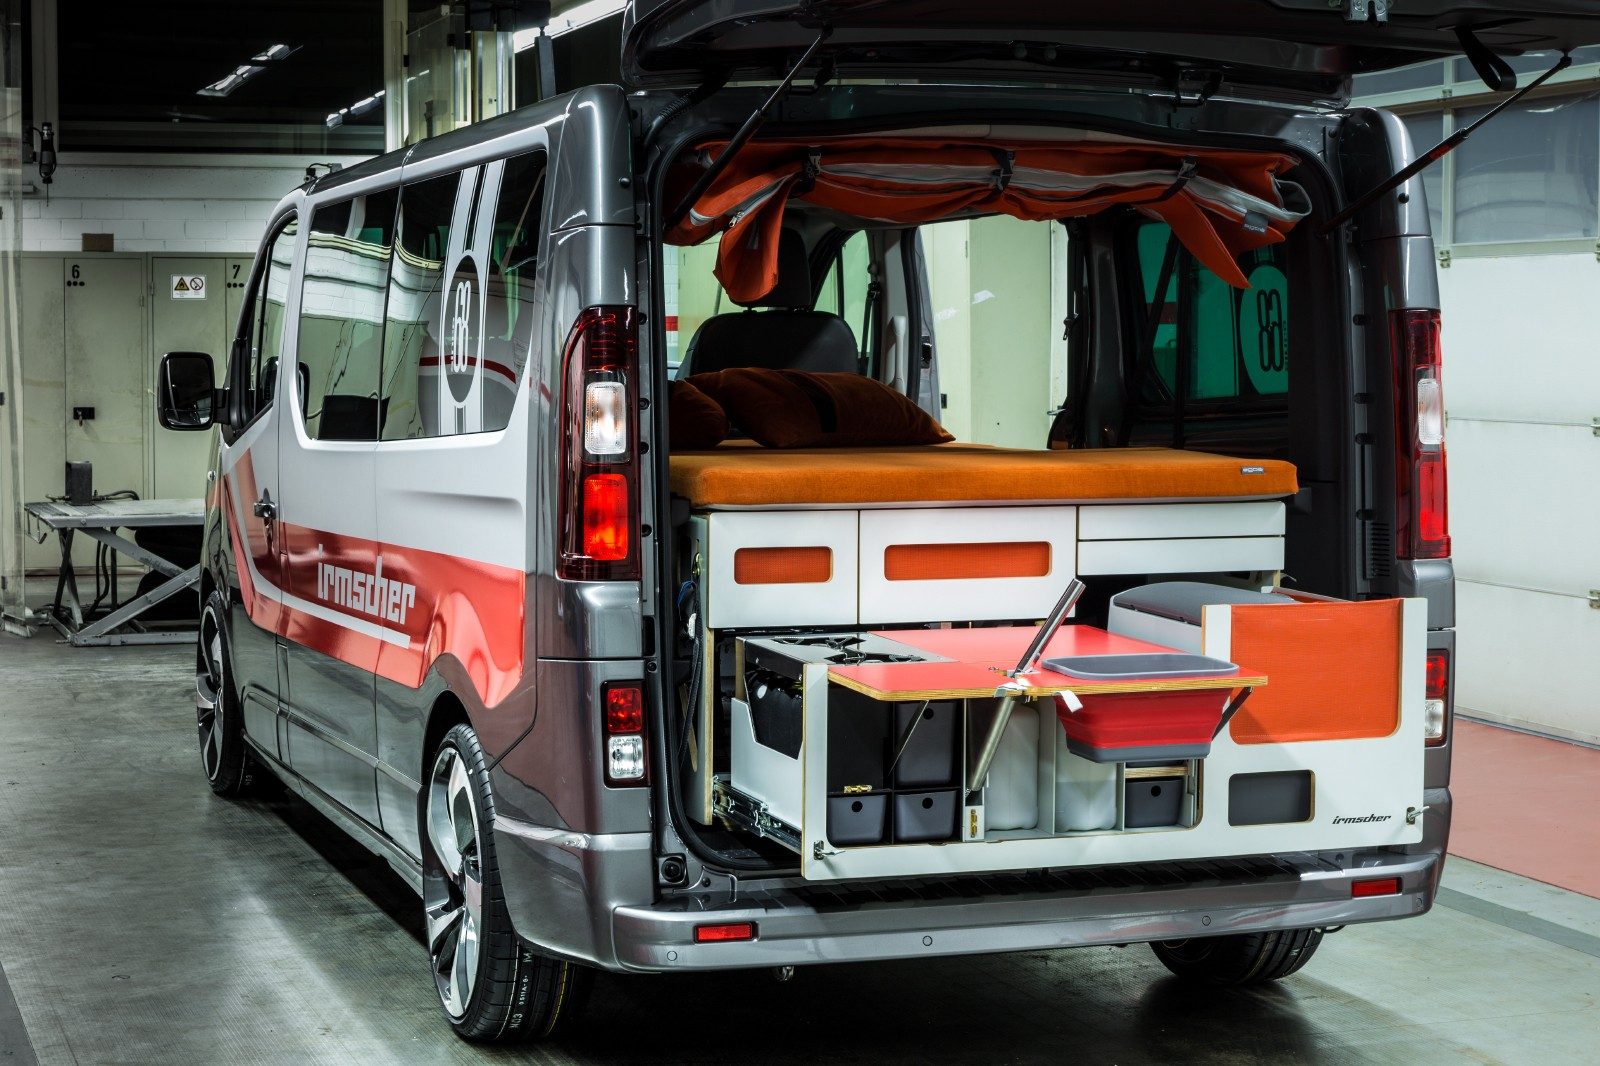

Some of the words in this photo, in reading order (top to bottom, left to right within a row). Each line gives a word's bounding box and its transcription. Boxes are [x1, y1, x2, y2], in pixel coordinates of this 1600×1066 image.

[72, 264, 80, 279] 6
[232, 264, 241, 279] 7
[317, 543, 416, 625] irmscher
[1331, 813, 1392, 825] irmscher
